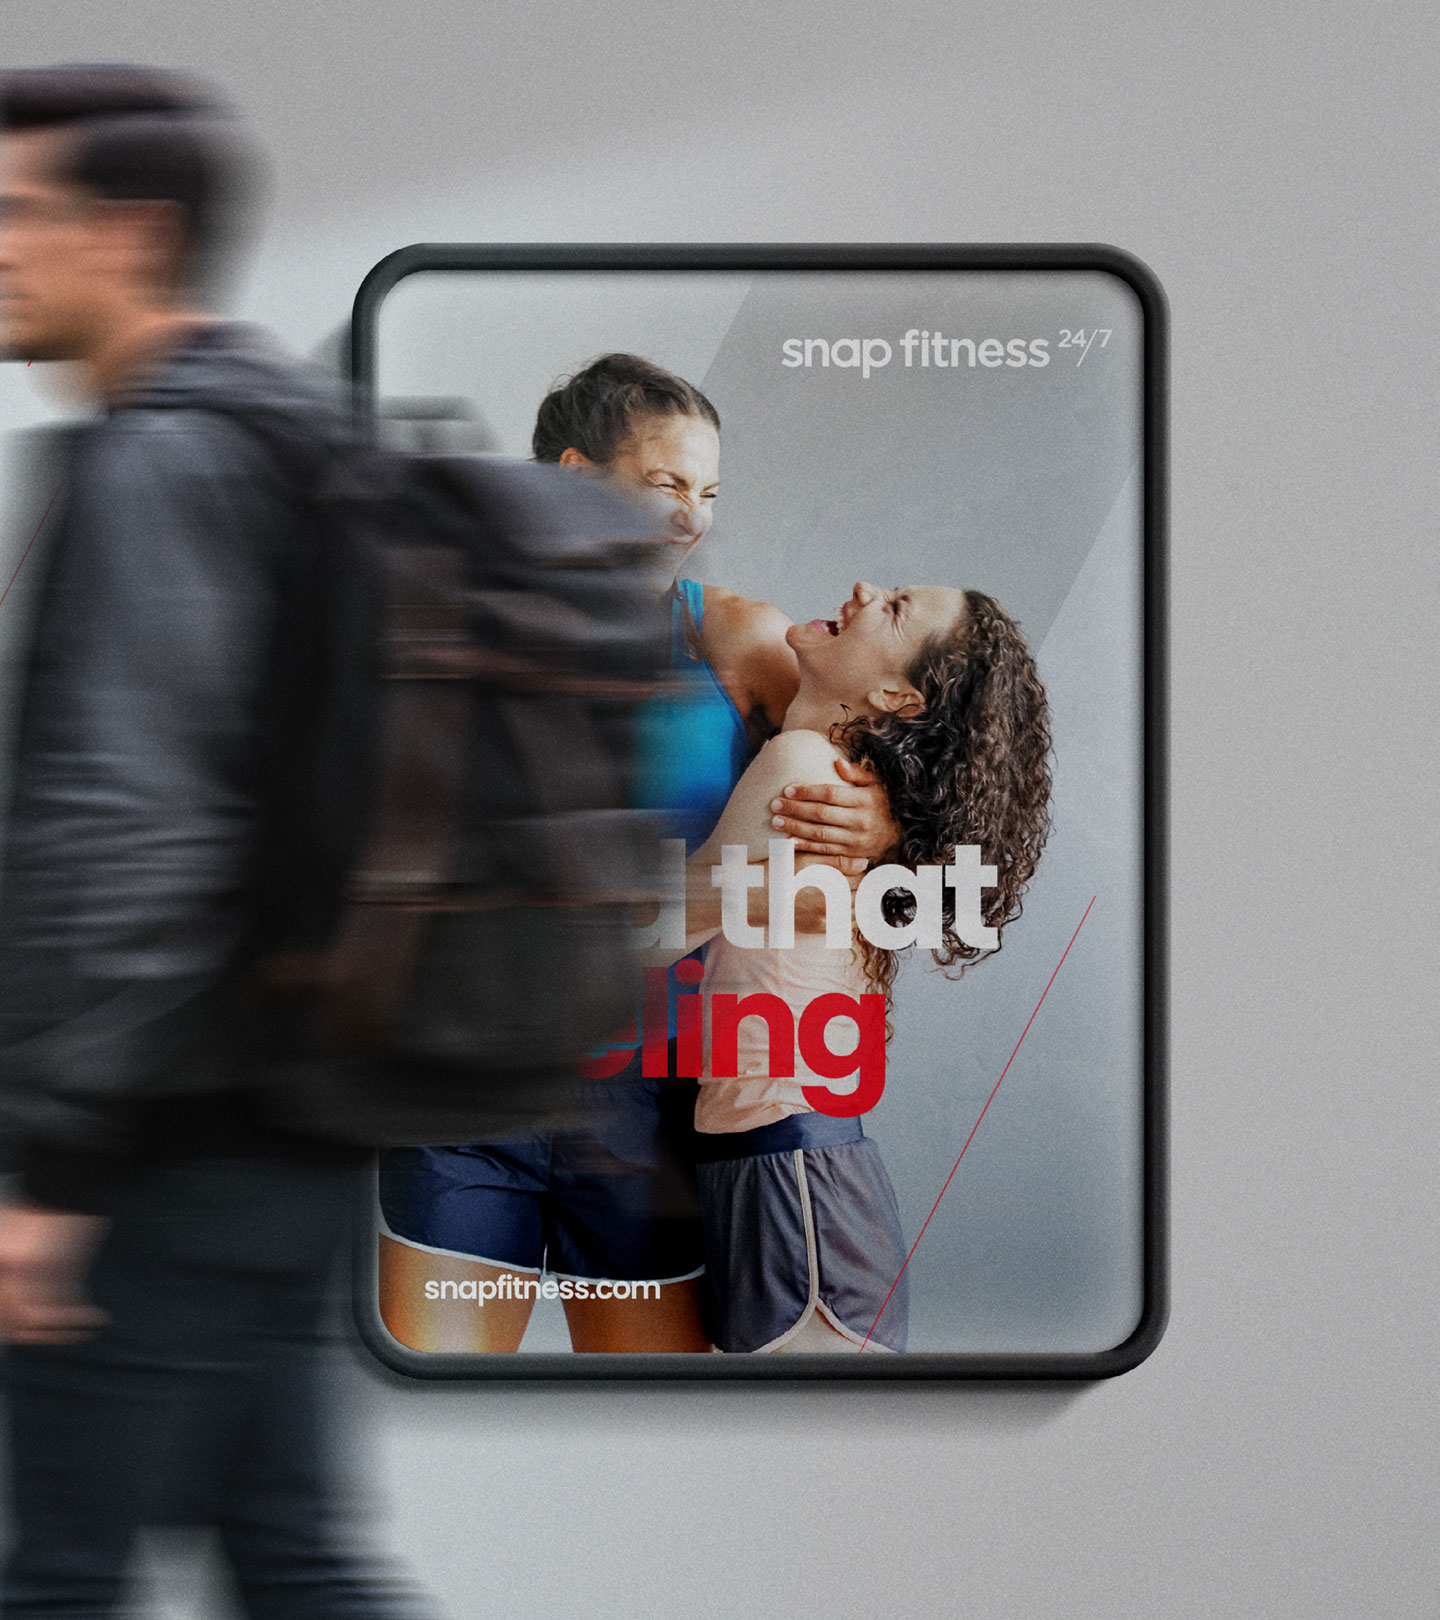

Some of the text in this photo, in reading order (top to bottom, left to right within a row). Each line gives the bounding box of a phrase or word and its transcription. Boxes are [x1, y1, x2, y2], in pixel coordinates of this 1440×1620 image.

[781, 328, 1113, 379] snap fitness 24/7
[711, 838, 999, 950] that
[423, 1273, 661, 1308] snapfitness.com
